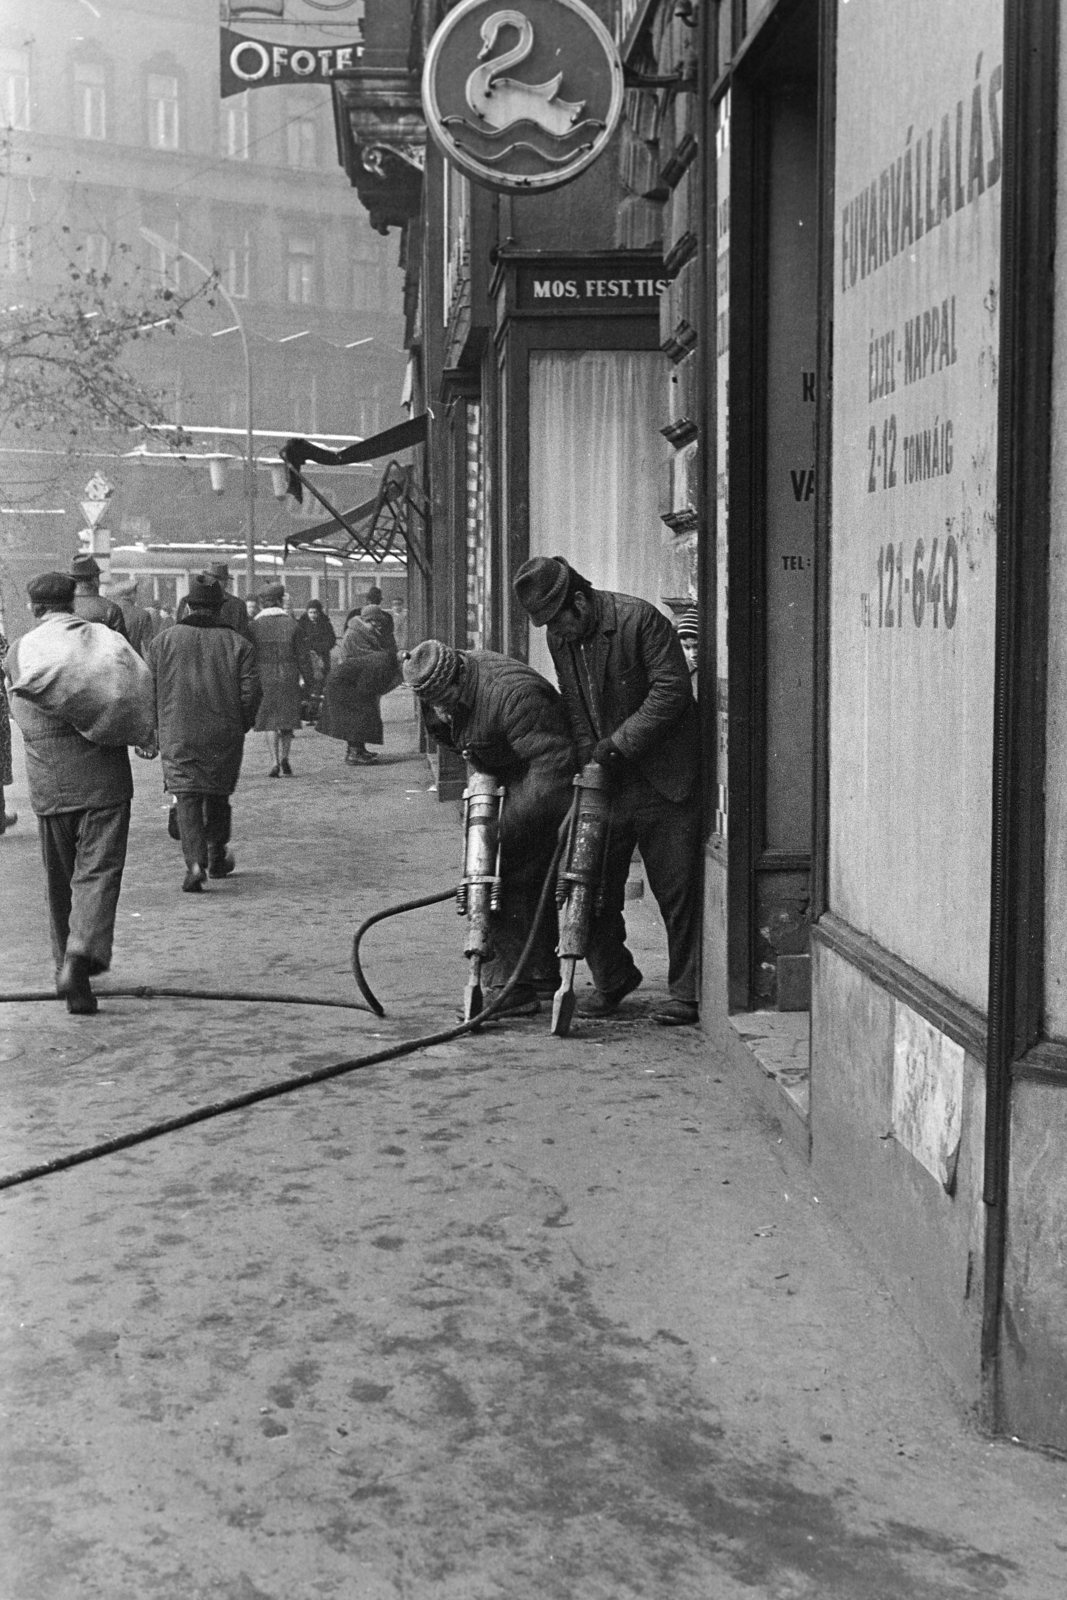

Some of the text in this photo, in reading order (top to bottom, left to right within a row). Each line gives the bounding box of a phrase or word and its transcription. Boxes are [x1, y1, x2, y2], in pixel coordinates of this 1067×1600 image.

[868, 413, 897, 493] 2-12
[903, 415, 953, 485] TONNÁIG
[877, 535, 958, 629] 121-640
